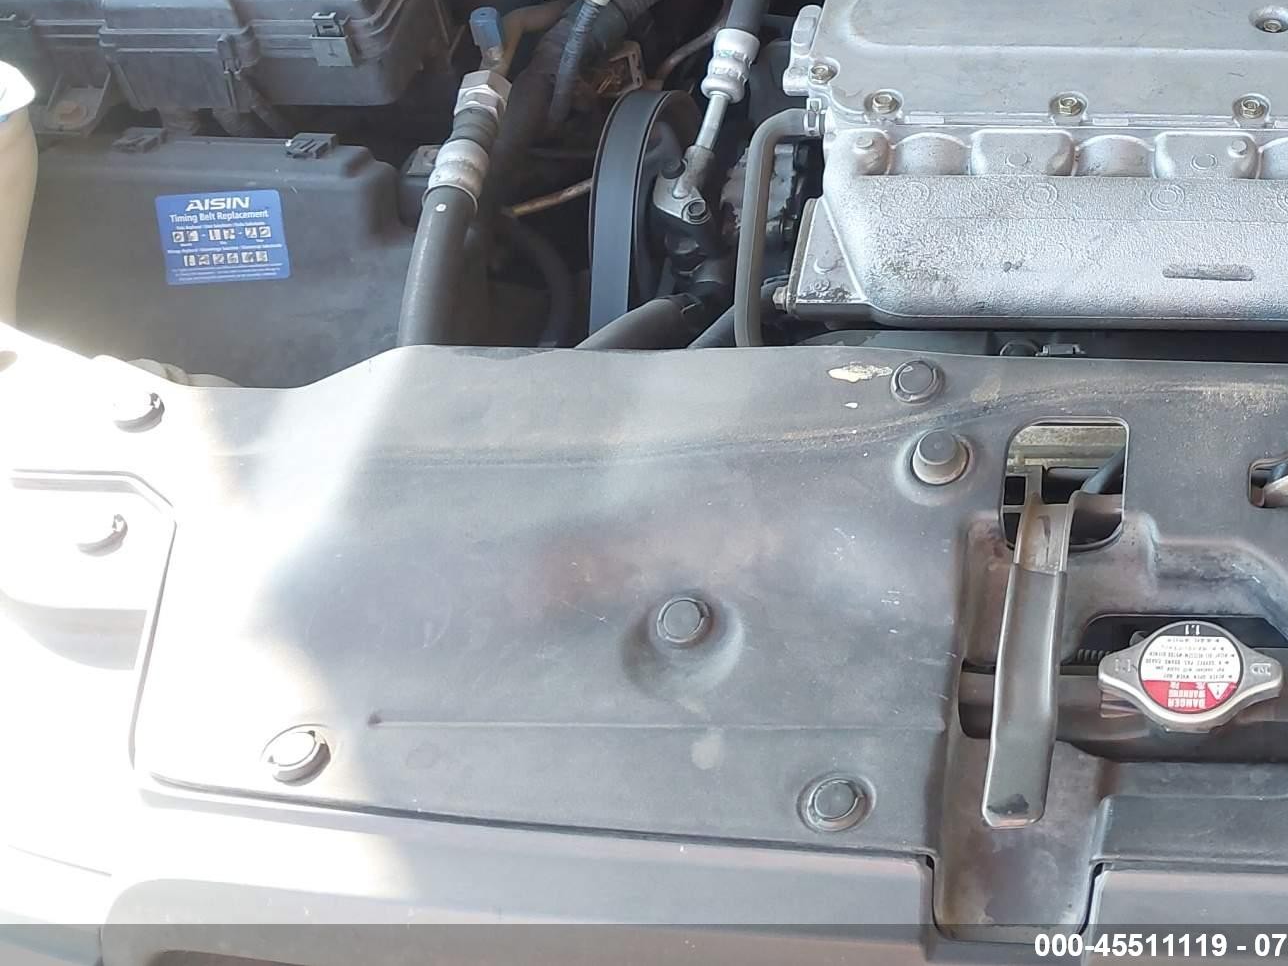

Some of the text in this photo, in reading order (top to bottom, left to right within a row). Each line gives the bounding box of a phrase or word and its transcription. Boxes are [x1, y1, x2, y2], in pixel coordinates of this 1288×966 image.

[185, 196, 250, 212] AISIN
[169, 209, 270, 223] Timing Belt Replacement
[1184, 624, 1200, 635] 1.1
[1168, 689, 1206, 698] WARNING
[1167, 697, 1206, 708] DANGER
